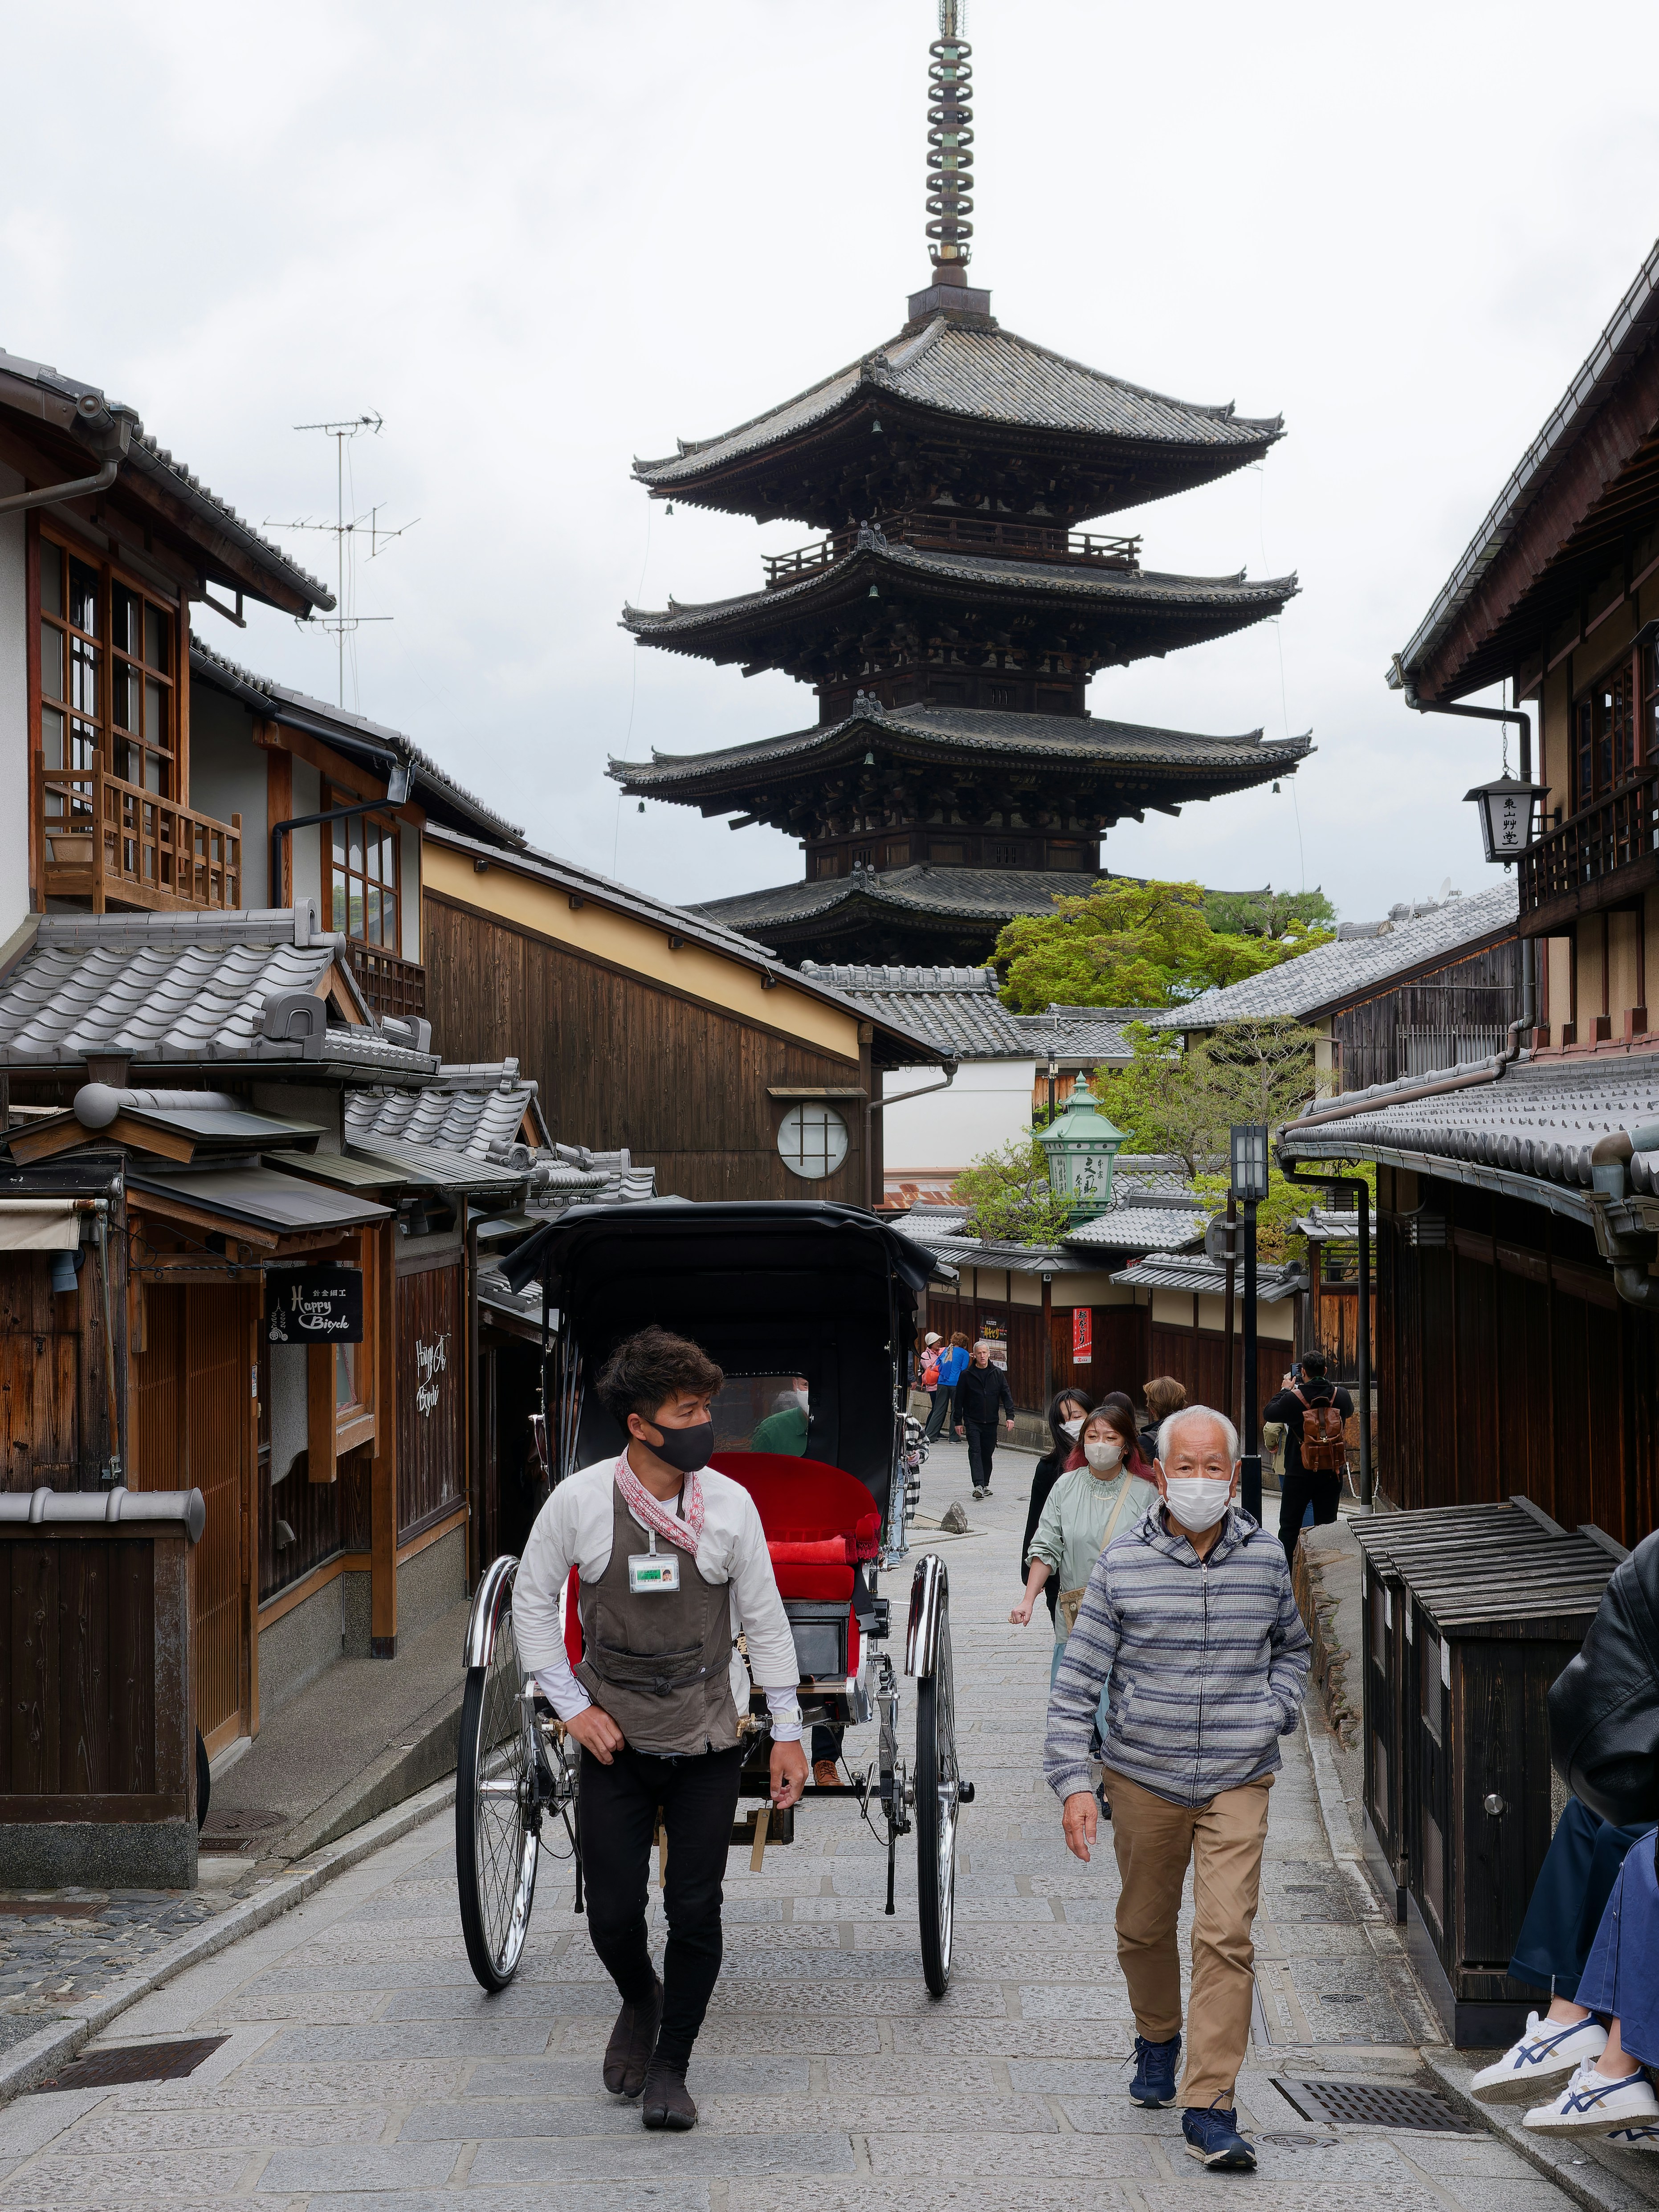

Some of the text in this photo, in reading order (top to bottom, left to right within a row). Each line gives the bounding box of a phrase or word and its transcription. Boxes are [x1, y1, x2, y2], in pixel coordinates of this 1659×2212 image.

[292, 1285, 331, 1315] Happy
[298, 1315, 349, 1333] Bicycle
[1078, 1310, 1087, 1346] 都をどり
